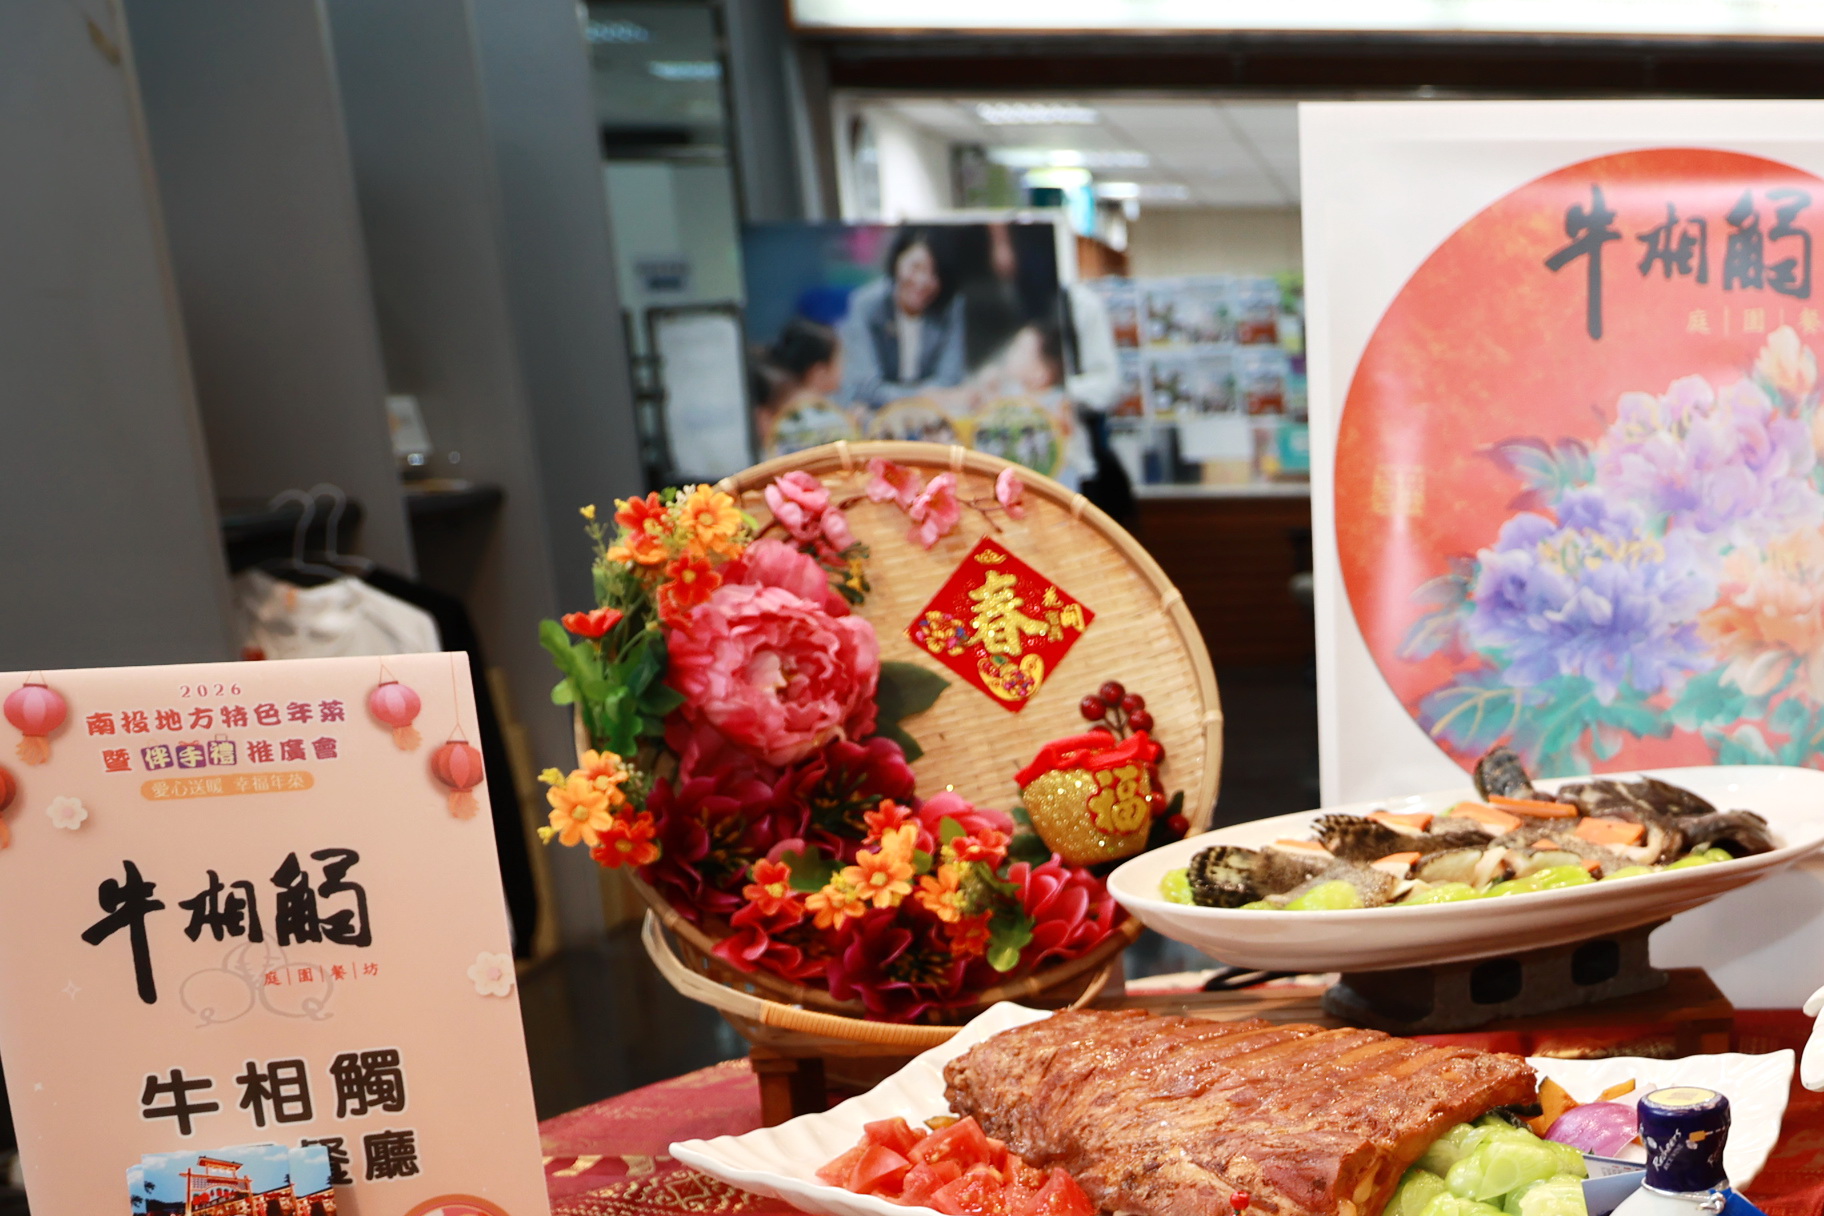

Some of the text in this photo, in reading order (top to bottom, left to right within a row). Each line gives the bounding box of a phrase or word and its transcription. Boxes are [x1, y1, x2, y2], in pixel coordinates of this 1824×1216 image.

[967, 570, 1049, 656] 春
[86, 700, 345, 736] 南投地方特色年菜
[180, 683, 241, 698] 2026
[141, 1048, 406, 1136] 牛相觸
